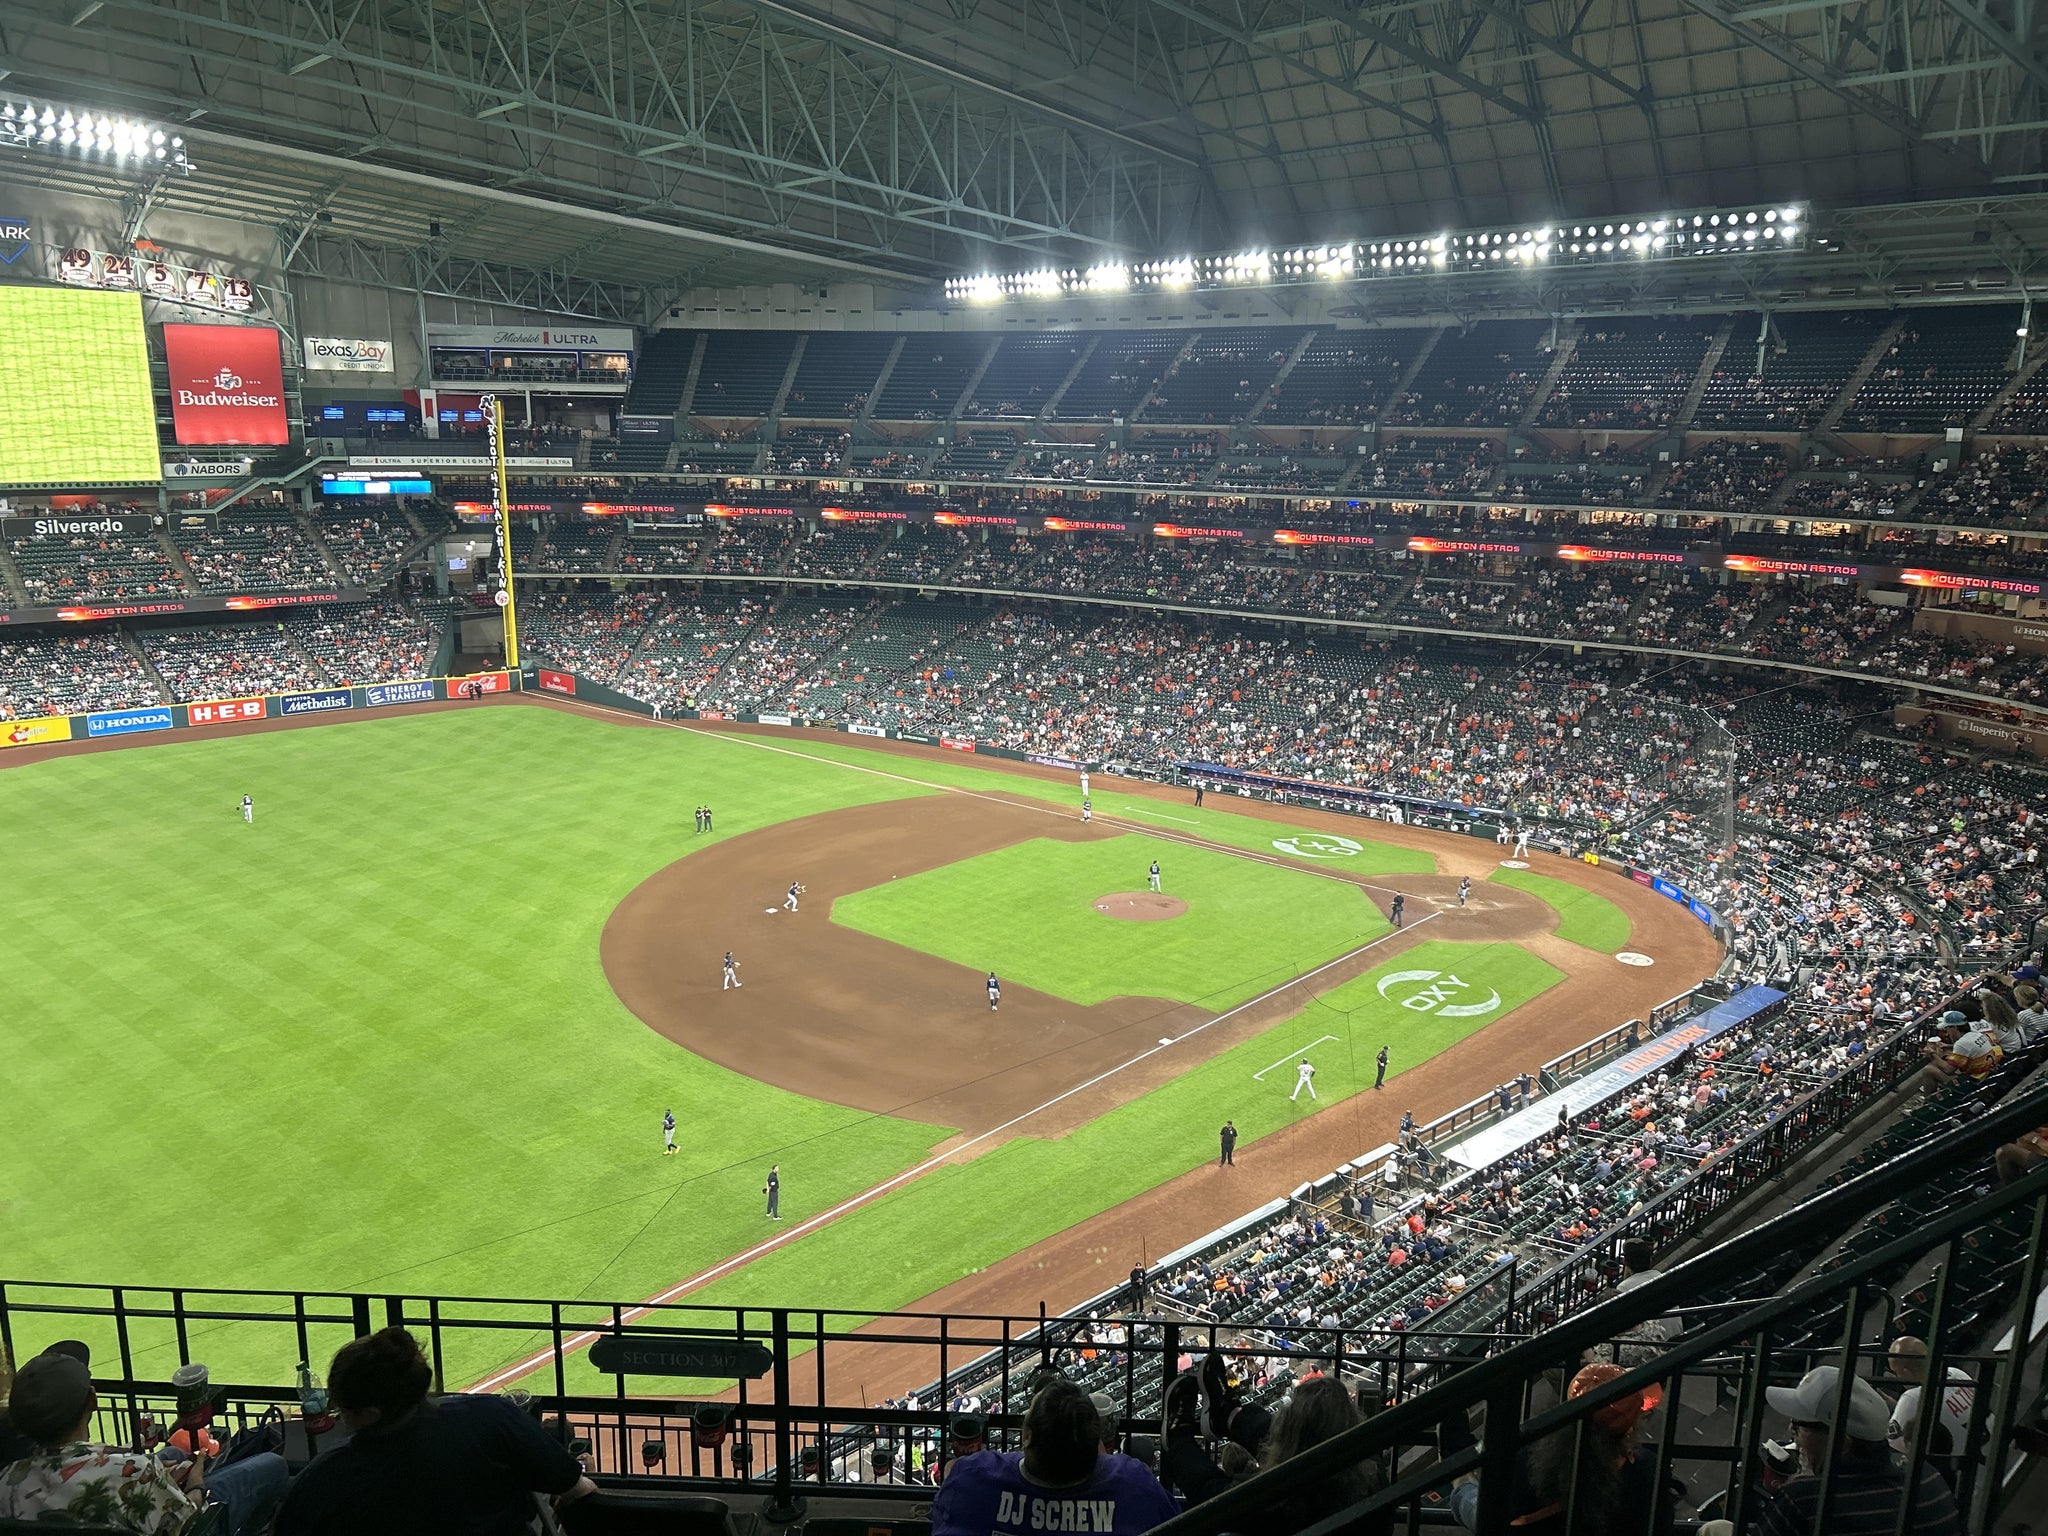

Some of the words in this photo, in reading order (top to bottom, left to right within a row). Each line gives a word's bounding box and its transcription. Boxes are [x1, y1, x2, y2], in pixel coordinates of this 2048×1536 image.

[63, 248, 91, 267] 49
[104, 255, 133, 275] 24
[154, 263, 167, 281] 5
[194, 271, 208, 290] 7
[226, 279, 251, 297] 13
[493, 331, 540, 344] Michelob
[553, 334, 598, 344] ULTRA
[310, 340, 352, 357] Texas
[358, 342, 386, 362] Bay
[178, 390, 279, 407] Budweiser
[486, 424, 498, 467] ROOT
[191, 465, 241, 475] NABORS
[490, 472, 498, 483] 4
[492, 488, 503, 520] THA
[35, 518, 123, 534] Silverado
[952, 515, 986, 523] HOUSTON
[1061, 520, 1094, 529] HOUSTON
[1172, 528, 1208, 536] HOUSTON
[1210, 529, 1243, 537] ASTROS
[1295, 533, 1335, 542] HOUSTON
[1337, 536, 1374, 544] ASTROS
[1432, 541, 1477, 550] HOUSTON
[1479, 543, 1520, 552] ASTROS
[1584, 549, 1635, 560] HOUSTON
[1638, 552, 1683, 562] ASTROS
[1752, 560, 1806, 571] HOUSTON
[1810, 564, 1858, 575] ASTROS
[1931, 575, 1988, 587] HOUSTON
[1992, 580, 2040, 593] ASTROS
[250, 597, 296, 605] HOUSTON
[300, 594, 338, 602] ASTROS
[84, 607, 137, 616] HOUSTON
[141, 604, 184, 613] ASTROS
[385, 683, 423, 694] ENERGY
[385, 690, 432, 702] TRANSFER
[287, 697, 347, 713] Methodist
[107, 715, 171, 728] HONDA
[1969, 722, 2011, 740] Insperity
[1401, 974, 1470, 1012] OXY
[1618, 1043, 1667, 1074] DAIKIN
[1663, 1024, 1710, 1051] PARK
[623, 1351, 703, 1366] SECTION
[712, 1354, 736, 1368] 307
[997, 1491, 1027, 1525] DJ
[1031, 1498, 1115, 1533] SCREW
